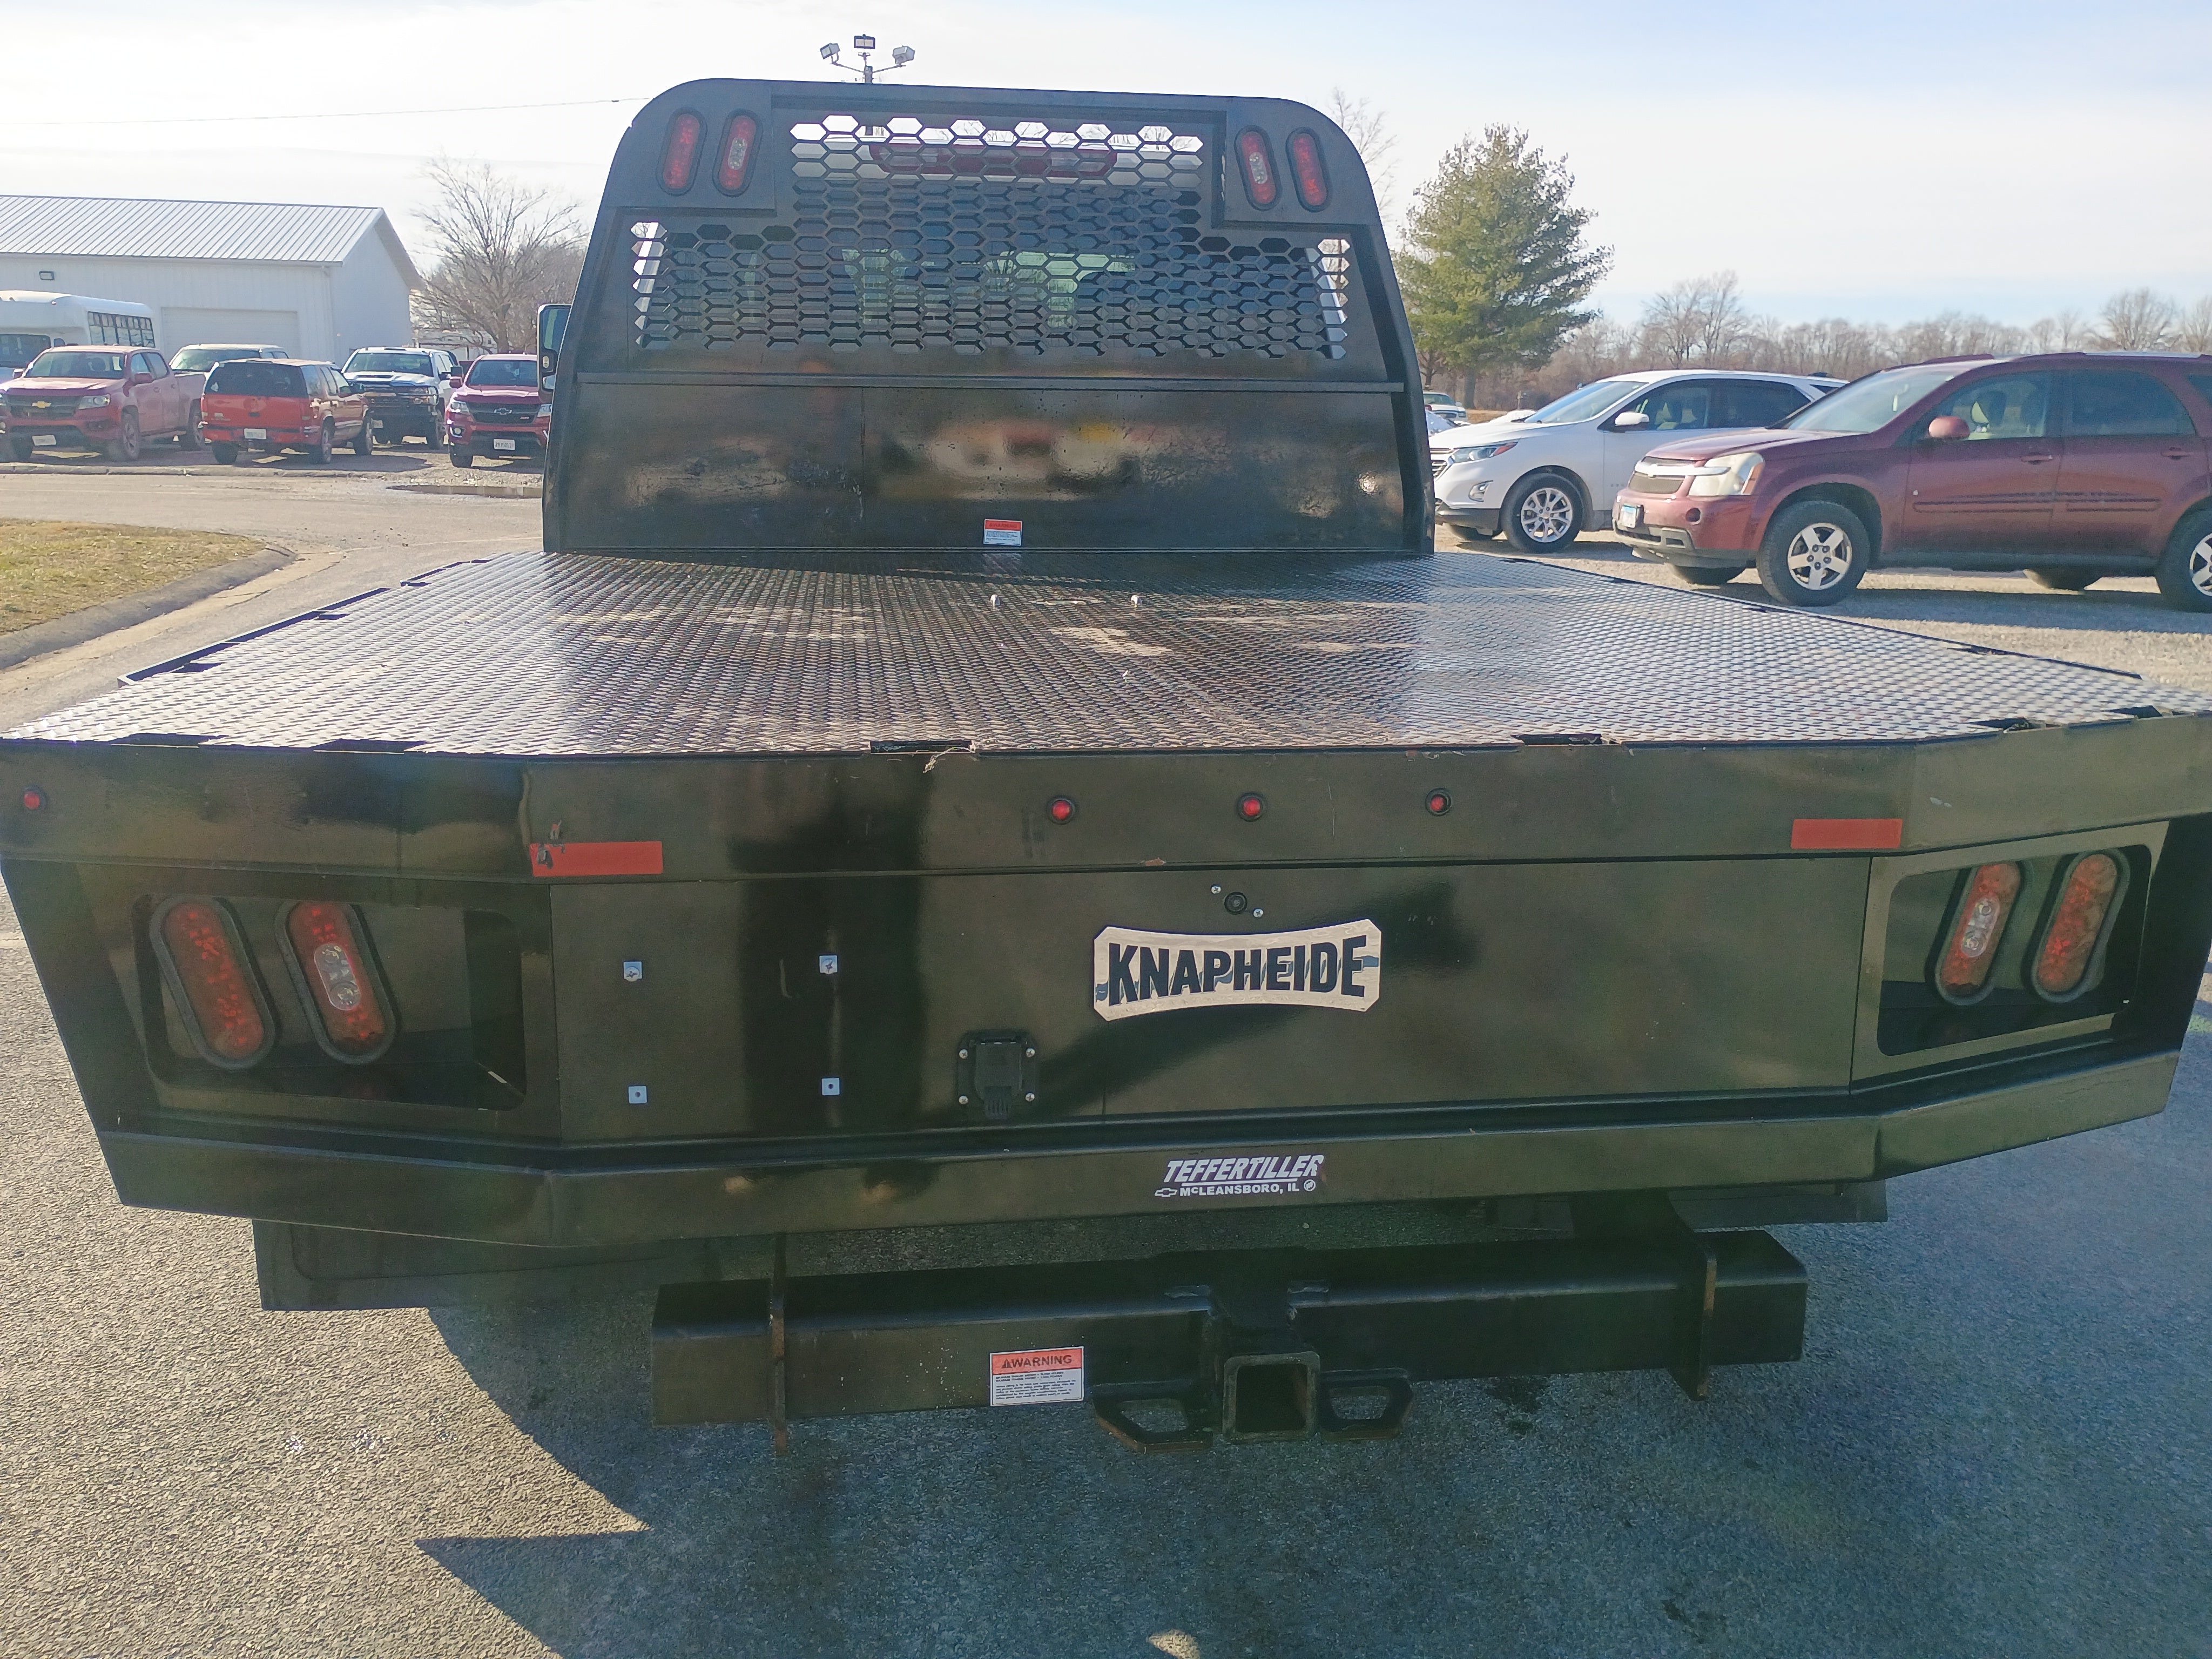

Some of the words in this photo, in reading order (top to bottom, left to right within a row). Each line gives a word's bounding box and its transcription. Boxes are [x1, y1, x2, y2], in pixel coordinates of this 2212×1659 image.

[1108, 934, 1367, 1007] KNAPHEIDE
[1163, 1155, 1324, 1183] TEFFERTILLER
[1287, 1183, 1300, 1192] IL
[1011, 1354, 1073, 1368] WARNING
